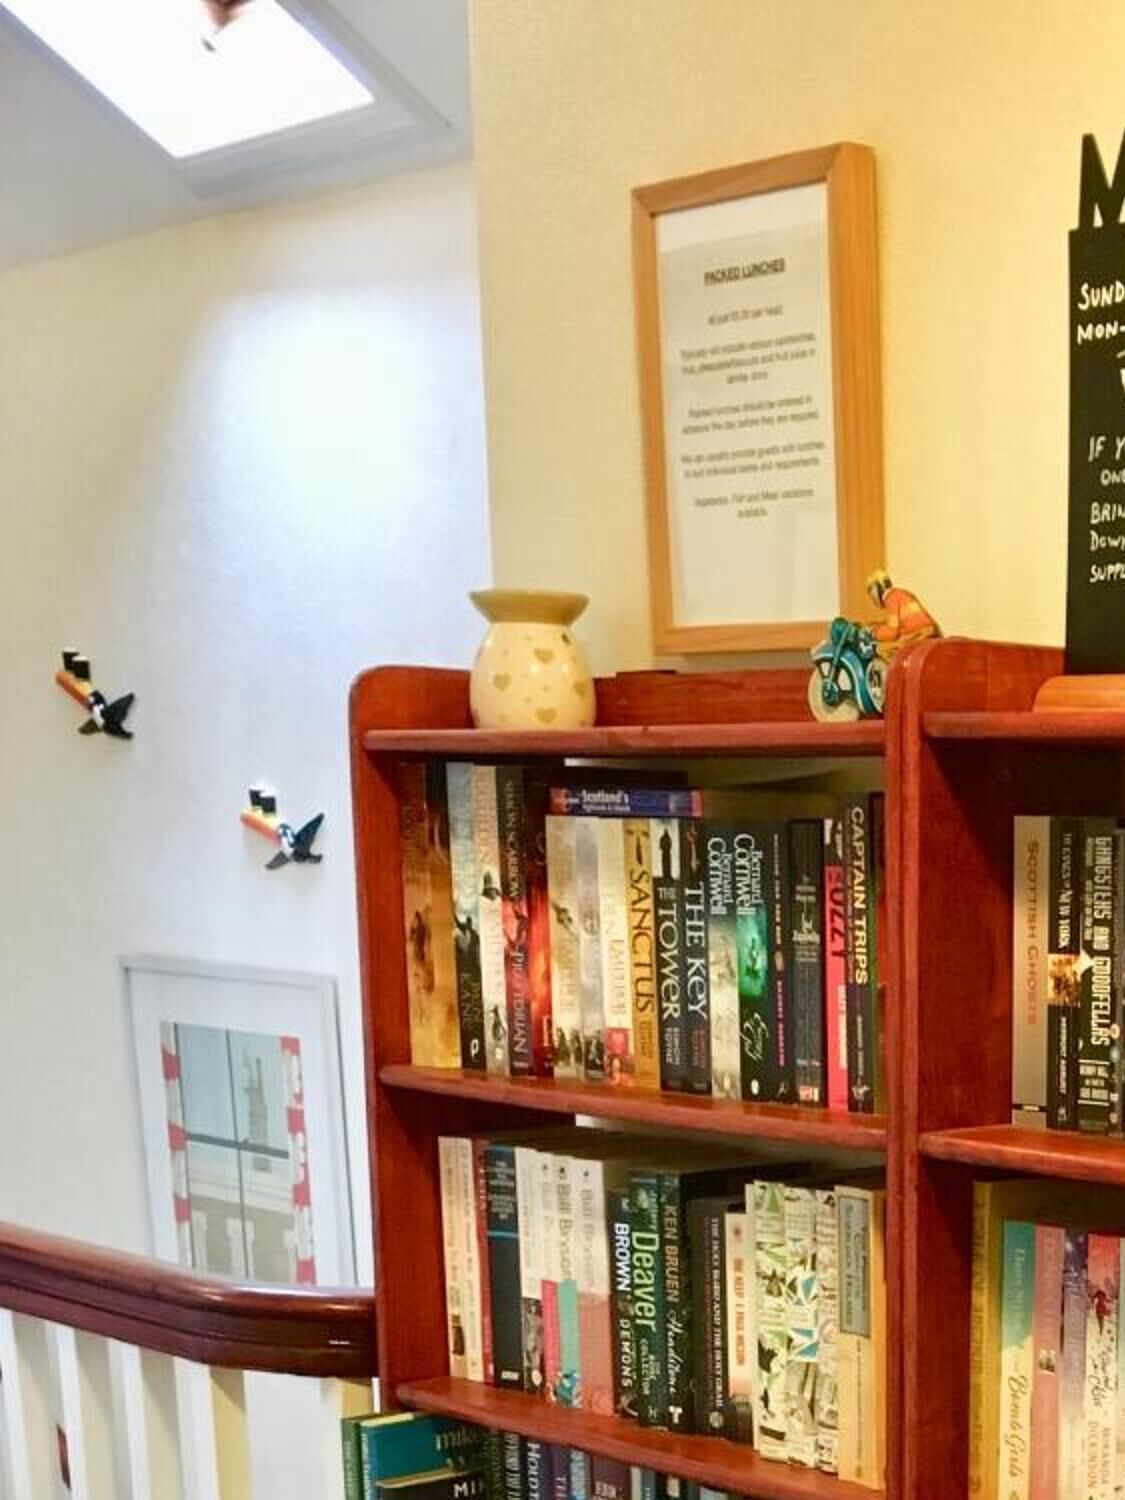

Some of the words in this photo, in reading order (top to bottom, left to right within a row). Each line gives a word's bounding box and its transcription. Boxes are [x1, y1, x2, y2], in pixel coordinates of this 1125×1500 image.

[704, 266, 740, 286] PACKED
[742, 258, 784, 279] LUNCHES
[1088, 436, 1106, 461] IF
[706, 837, 729, 916] Cornwell
[722, 853, 733, 904] Bernard
[733, 833, 756, 916] Cornwell
[750, 850, 764, 904] Bernard
[851, 806, 867, 908] CAPTAIN
[1024, 838, 1040, 939] SCOTTISH
[1093, 837, 1114, 920] GANGSTERS
[629, 868, 655, 1013] SANCTUS
[684, 882, 705, 947] THE
[1093, 925, 1111, 950] AND
[853, 917, 869, 985] TRIPS
[1090, 956, 1112, 1046] GOODFELLAS
[664, 1206, 679, 1238] KEN
[614, 1223, 631, 1292] BROWN
[632, 1231, 659, 1333] Deaver
[665, 1245, 681, 1302] BRUEN
[619, 1319, 633, 1387] DEMONS
[1007, 1376, 1030, 1430] Bomb
[526, 1443, 541, 1497] HOLD
[1006, 1432, 1028, 1478] Girls
[1087, 1421, 1099, 1489] DICKINSON
[1099, 1427, 1111, 1486] MIRANDA
